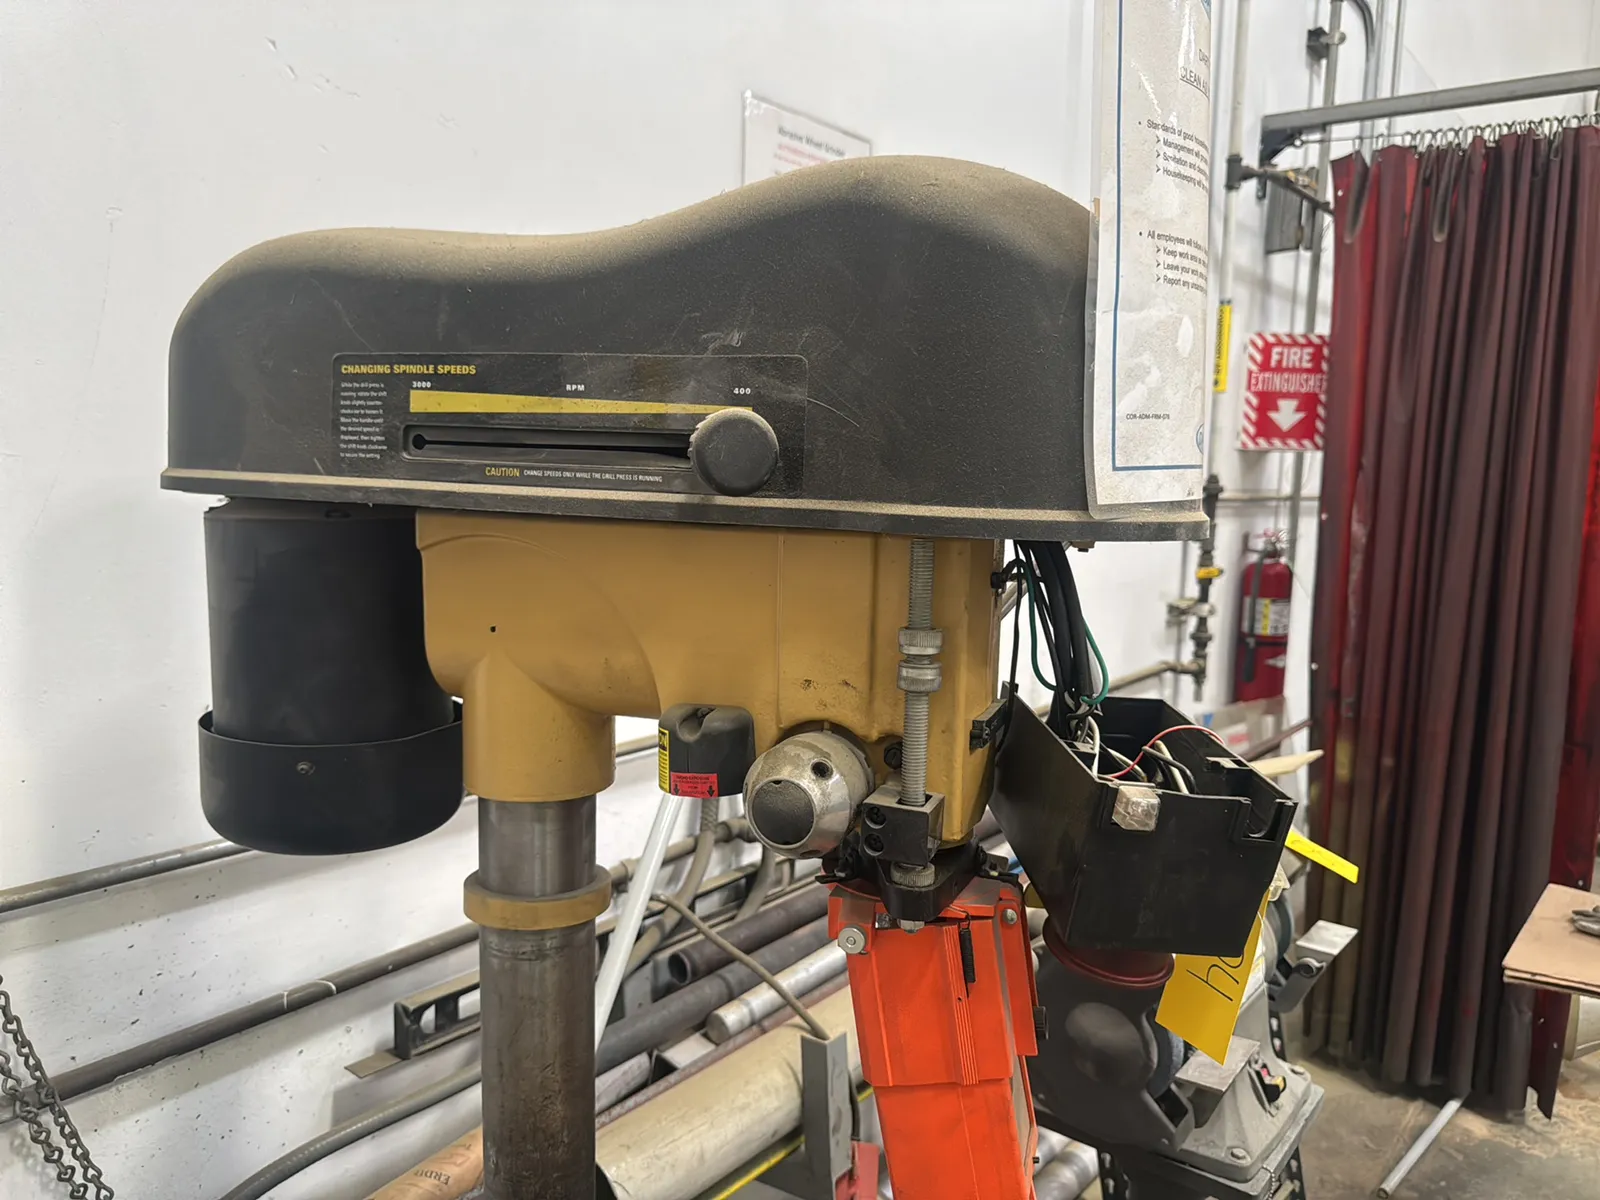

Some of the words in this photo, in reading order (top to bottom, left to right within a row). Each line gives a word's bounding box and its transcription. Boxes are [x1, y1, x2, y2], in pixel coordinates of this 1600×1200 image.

[1180, 66, 1201, 87] CLEAN
[1147, 119, 1176, 135] Standards
[1183, 131, 1194, 142] good
[1163, 137, 1194, 156] Management
[1163, 166, 1196, 187] Housekeeping
[1147, 230, 1155, 240] All
[1157, 233, 1185, 245] employees
[1163, 246, 1177, 258] Keep
[1178, 251, 1189, 260] work
[1163, 260, 1179, 272] Leave
[1180, 266, 1191, 275] your
[1163, 274, 1181, 287] Report
[1182, 280, 1190, 289] any
[1270, 347, 1314, 368] FIRE
[341, 365, 391, 374] CHANGING
[393, 365, 435, 374] SPINDLE
[437, 365, 477, 374] SPEEDS
[566, 384, 585, 392] RPM
[733, 387, 751, 395] 400
[485, 467, 520, 477] CAUTION
[523, 469, 543, 477] CHANGE
[543, 470, 562, 478] SPEEDS
[575, 471, 591, 479] WHILE
[616, 473, 632, 481] PRESS
[638, 475, 663, 483] RUNNING
